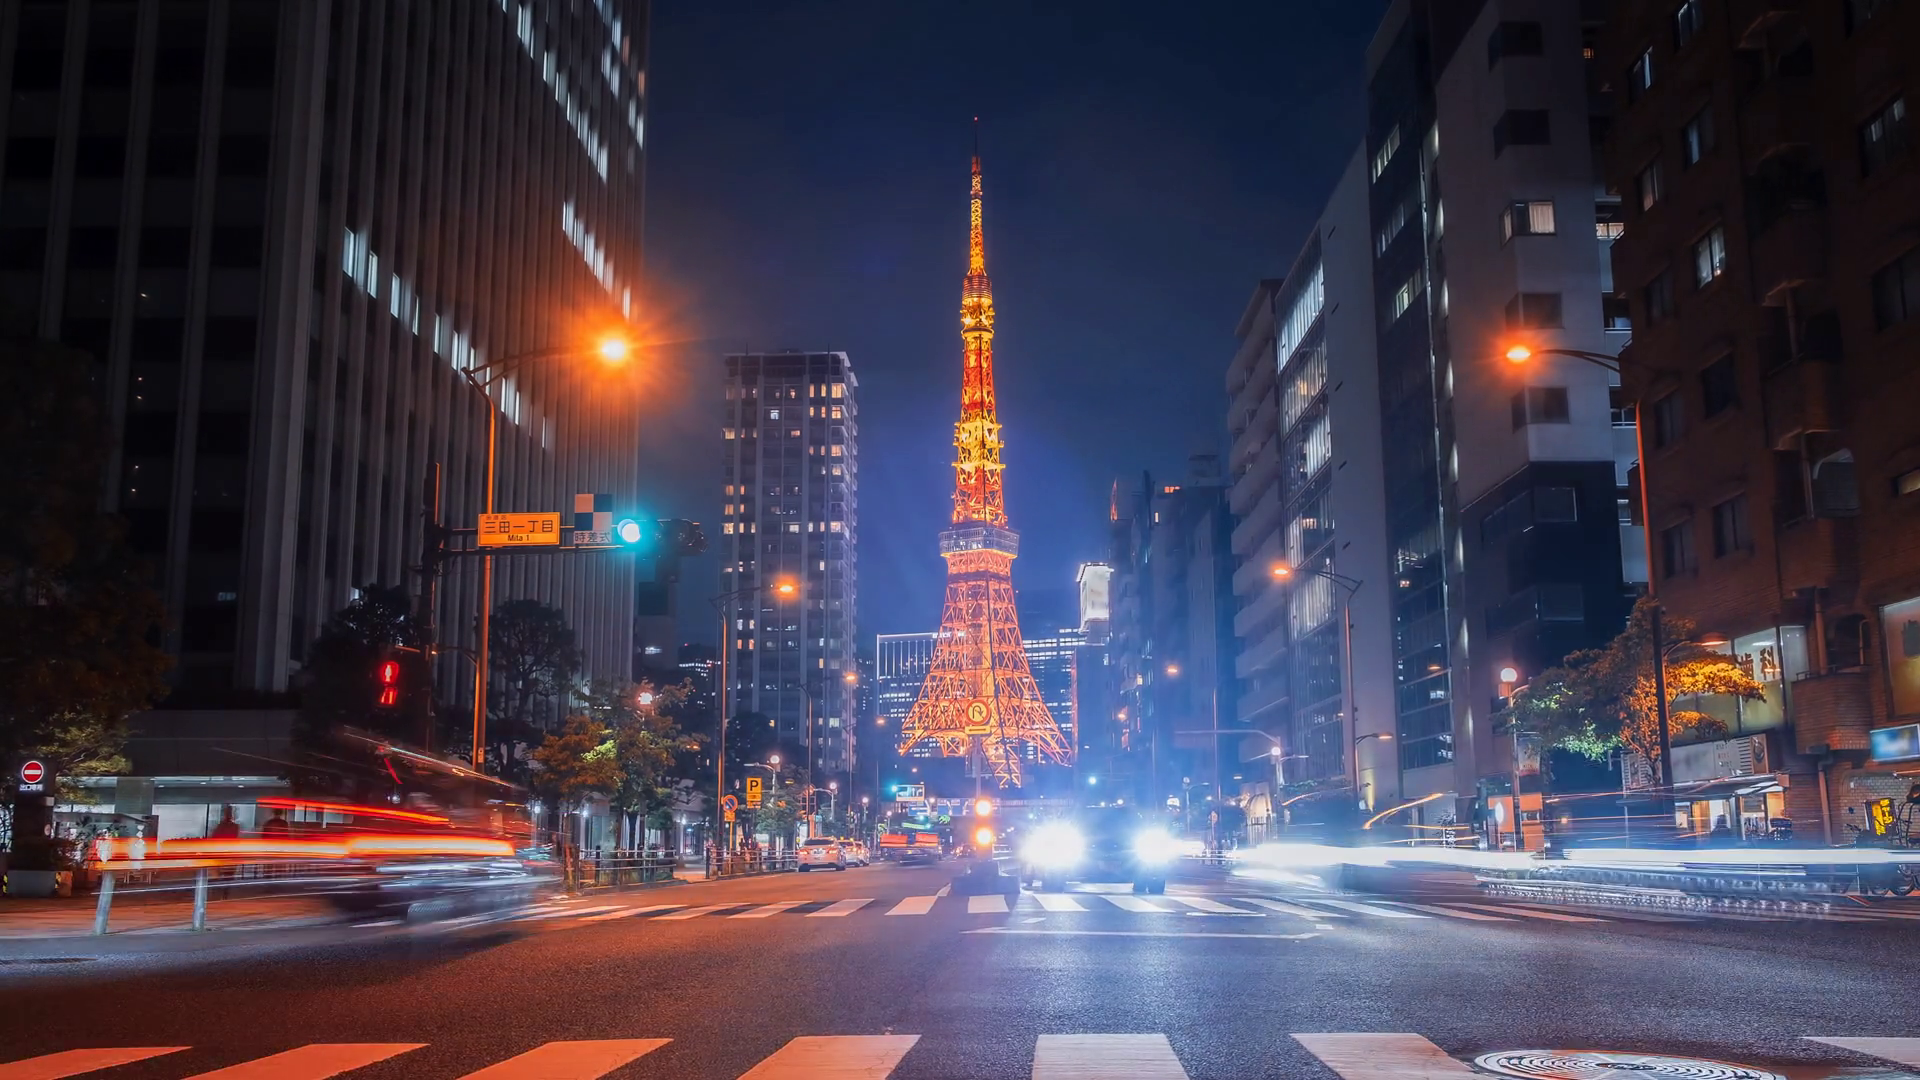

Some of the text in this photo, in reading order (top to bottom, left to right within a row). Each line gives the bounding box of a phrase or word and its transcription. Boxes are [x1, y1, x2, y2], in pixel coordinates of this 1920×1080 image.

[484, 520, 553, 533] 三田一丁目
[507, 534, 523, 542] Mita
[575, 532, 610, 543] 時差式
[750, 780, 759, 791] P
